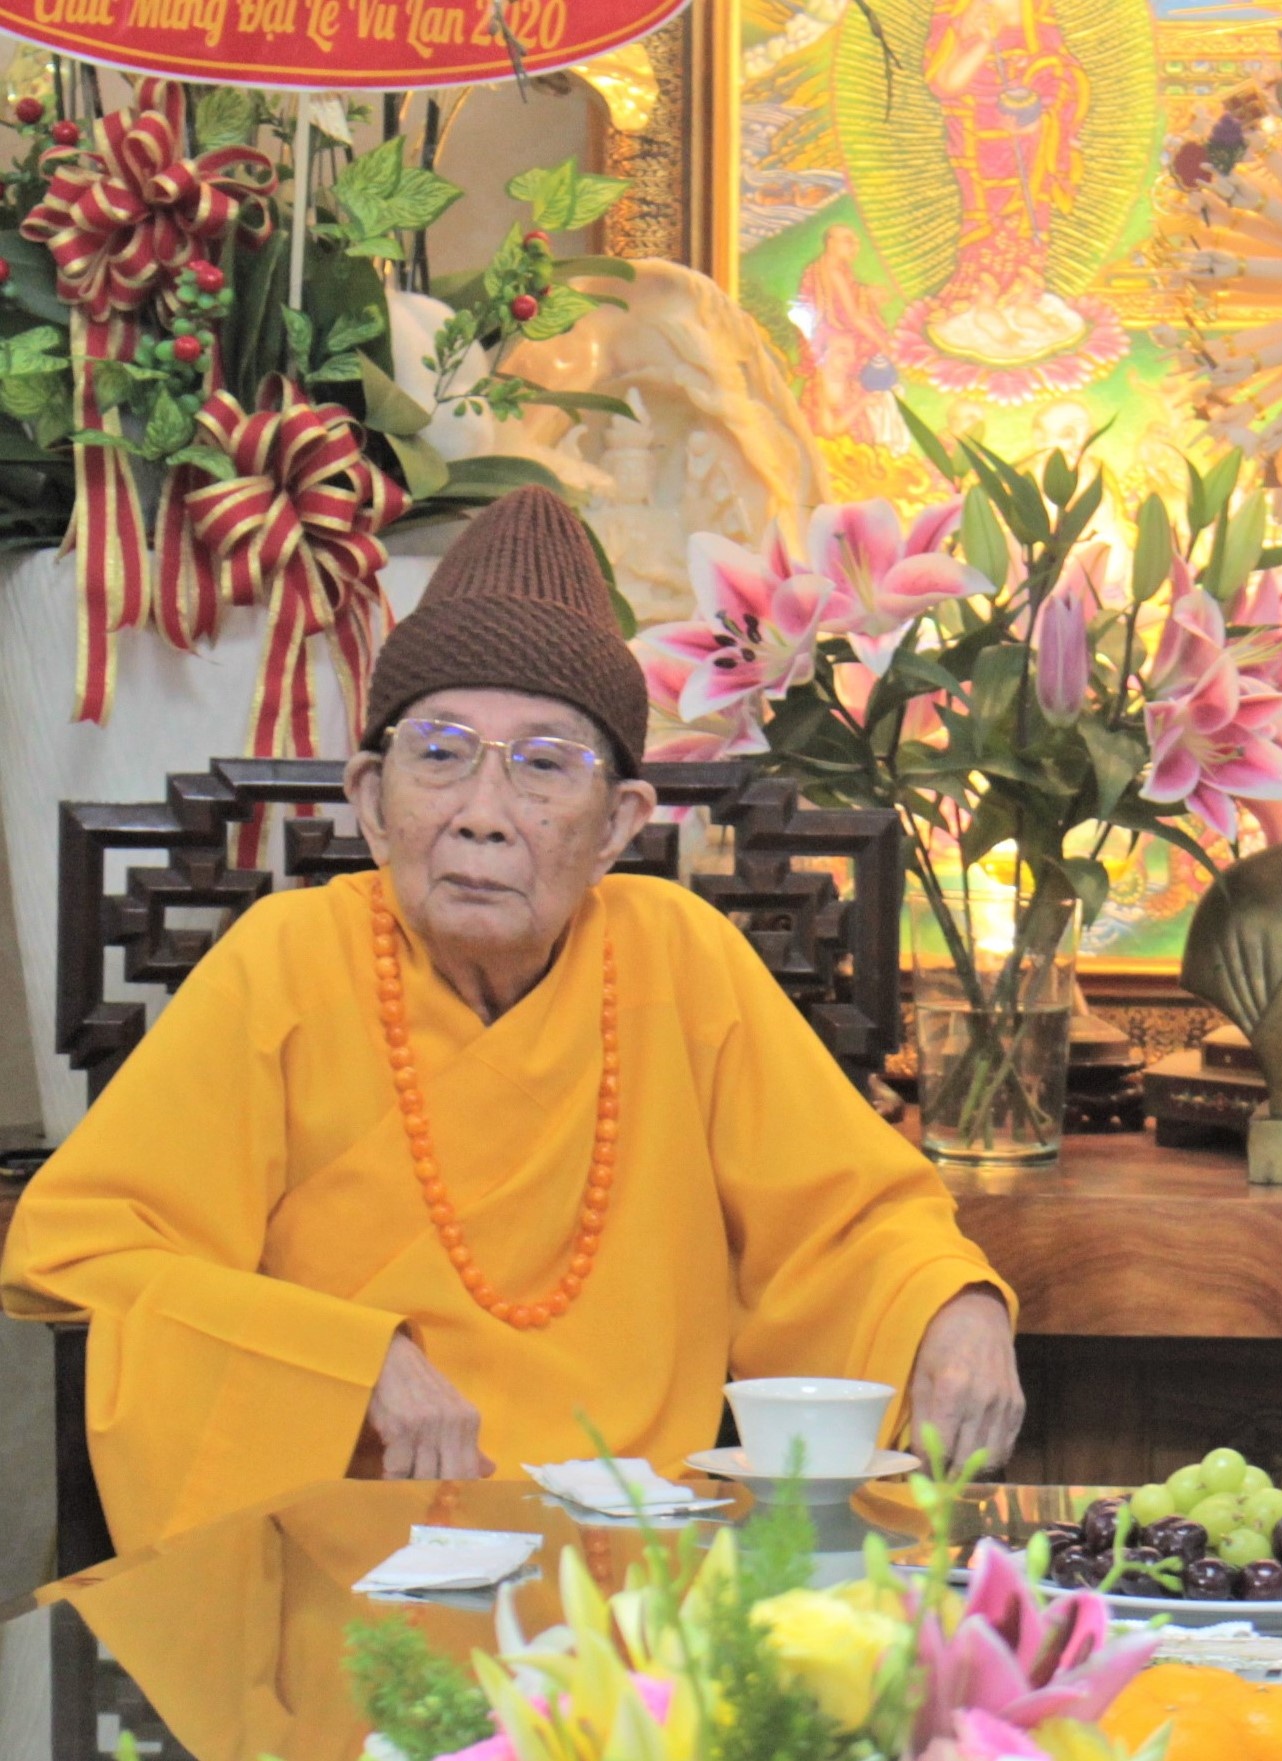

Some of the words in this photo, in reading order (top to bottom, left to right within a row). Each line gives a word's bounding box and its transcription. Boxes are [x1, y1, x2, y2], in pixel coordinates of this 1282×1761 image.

[349, 0, 397, 41] Vu
[406, 0, 464, 58] Lan
[471, 0, 566, 50] 2020
